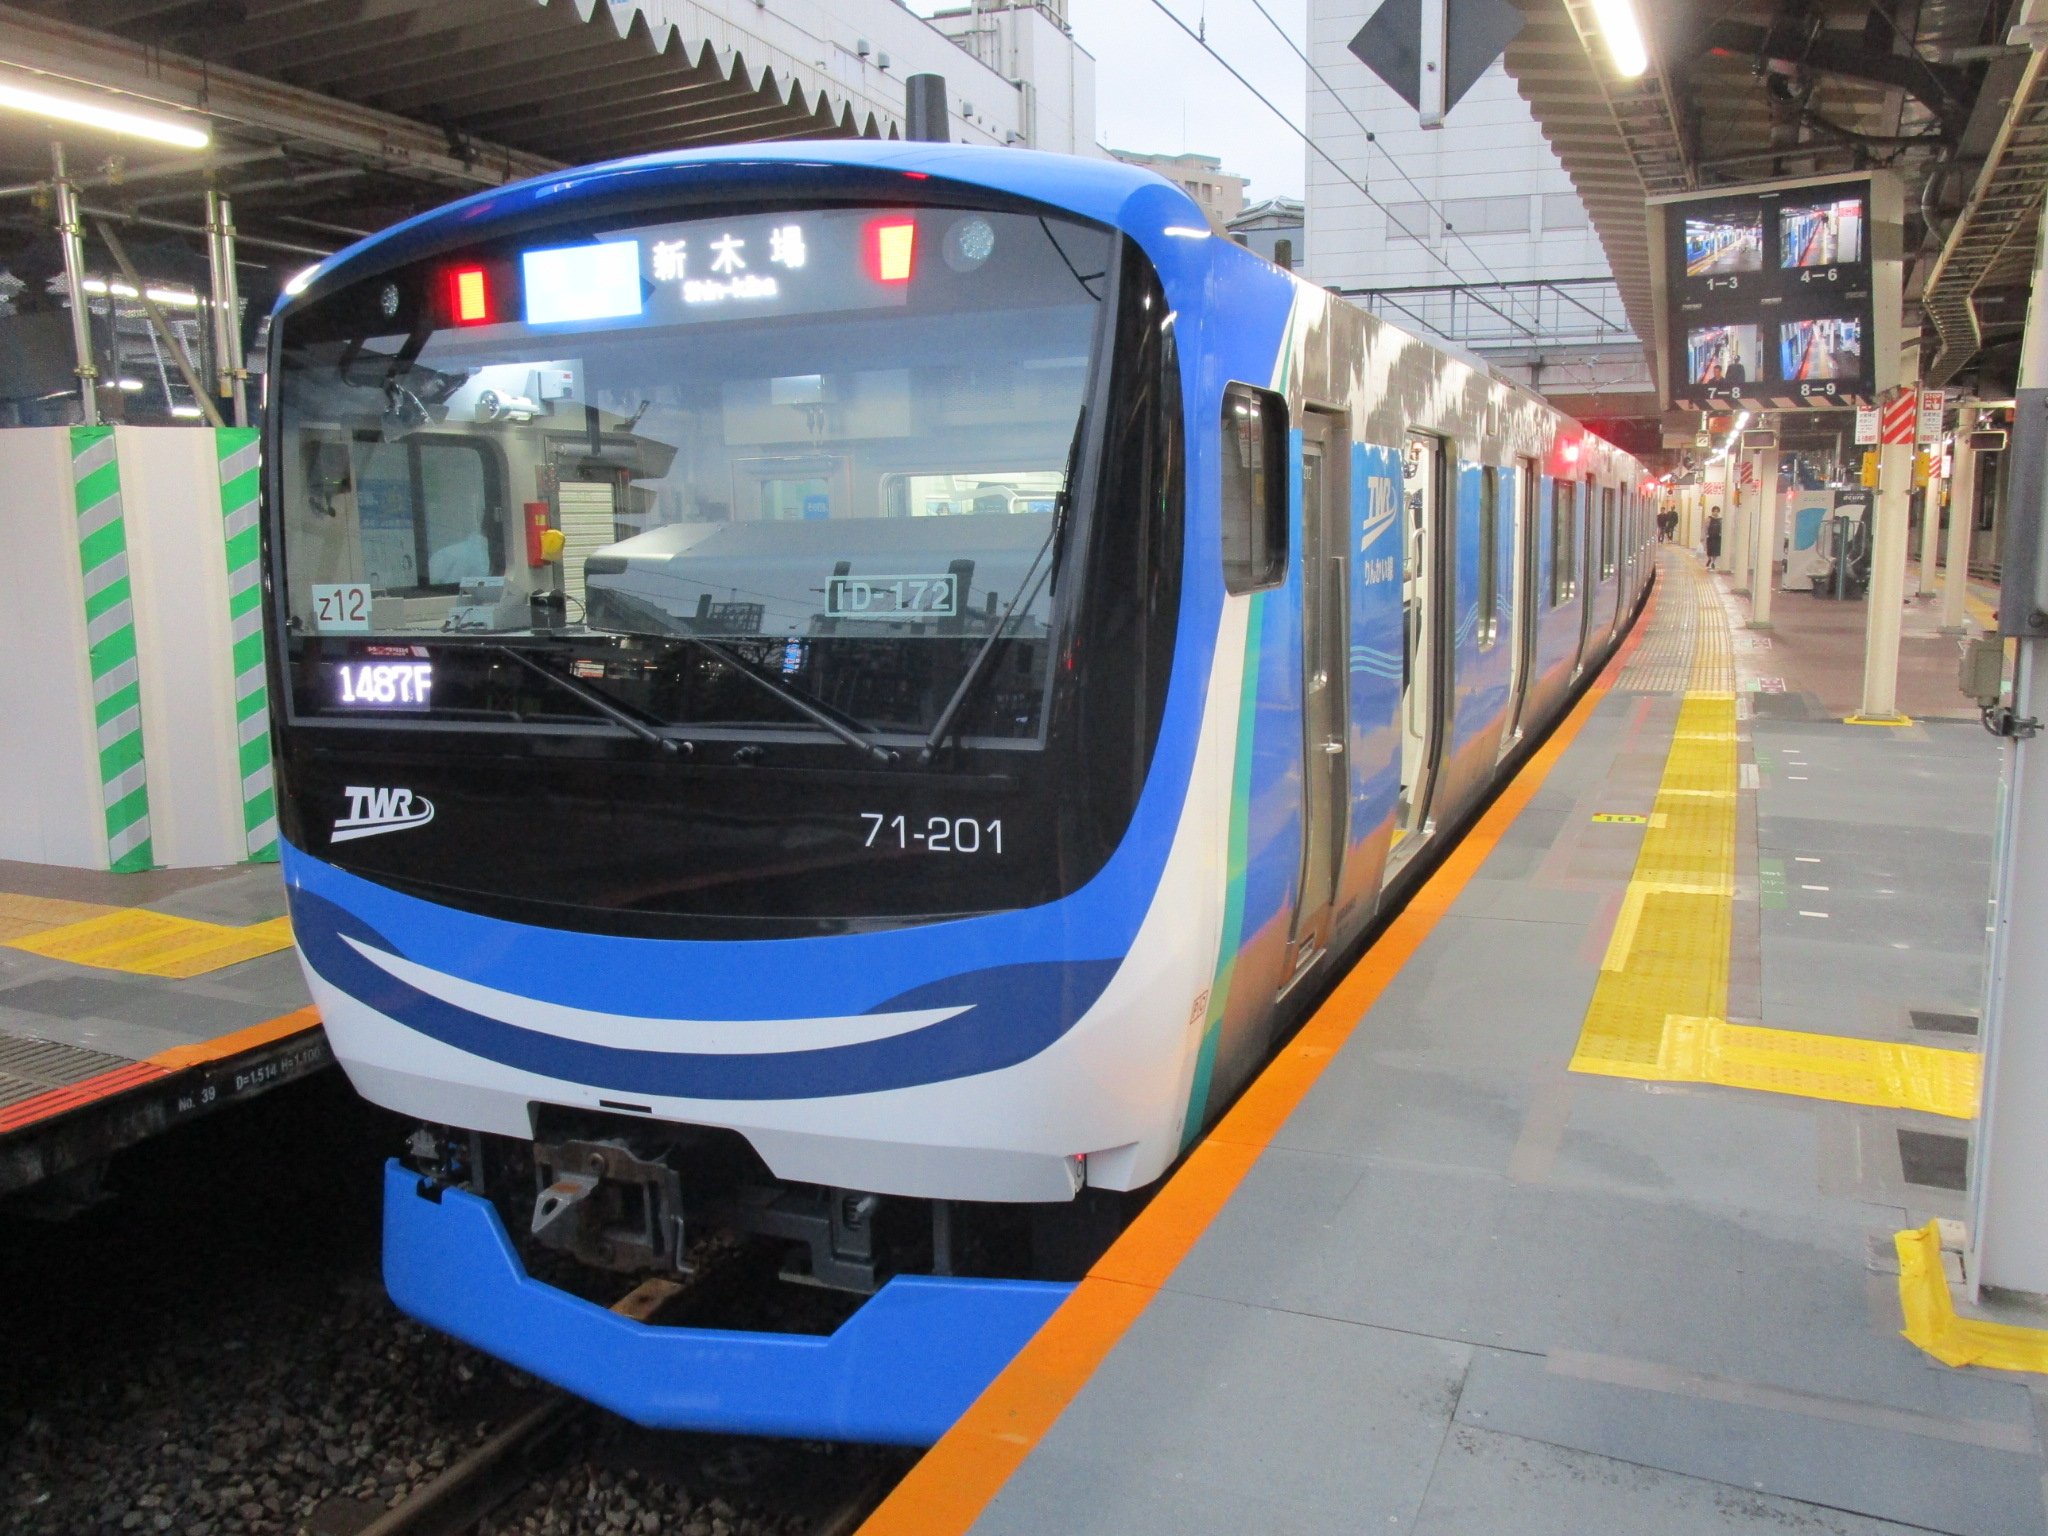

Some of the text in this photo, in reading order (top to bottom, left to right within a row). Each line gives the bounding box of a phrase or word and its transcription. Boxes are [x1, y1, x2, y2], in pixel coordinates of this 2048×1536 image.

[1799, 268, 1838, 284] 4-6
[1707, 386, 1741, 400] 7-8
[340, 665, 432, 702] 1487F
[860, 812, 1004, 855] 71-201
